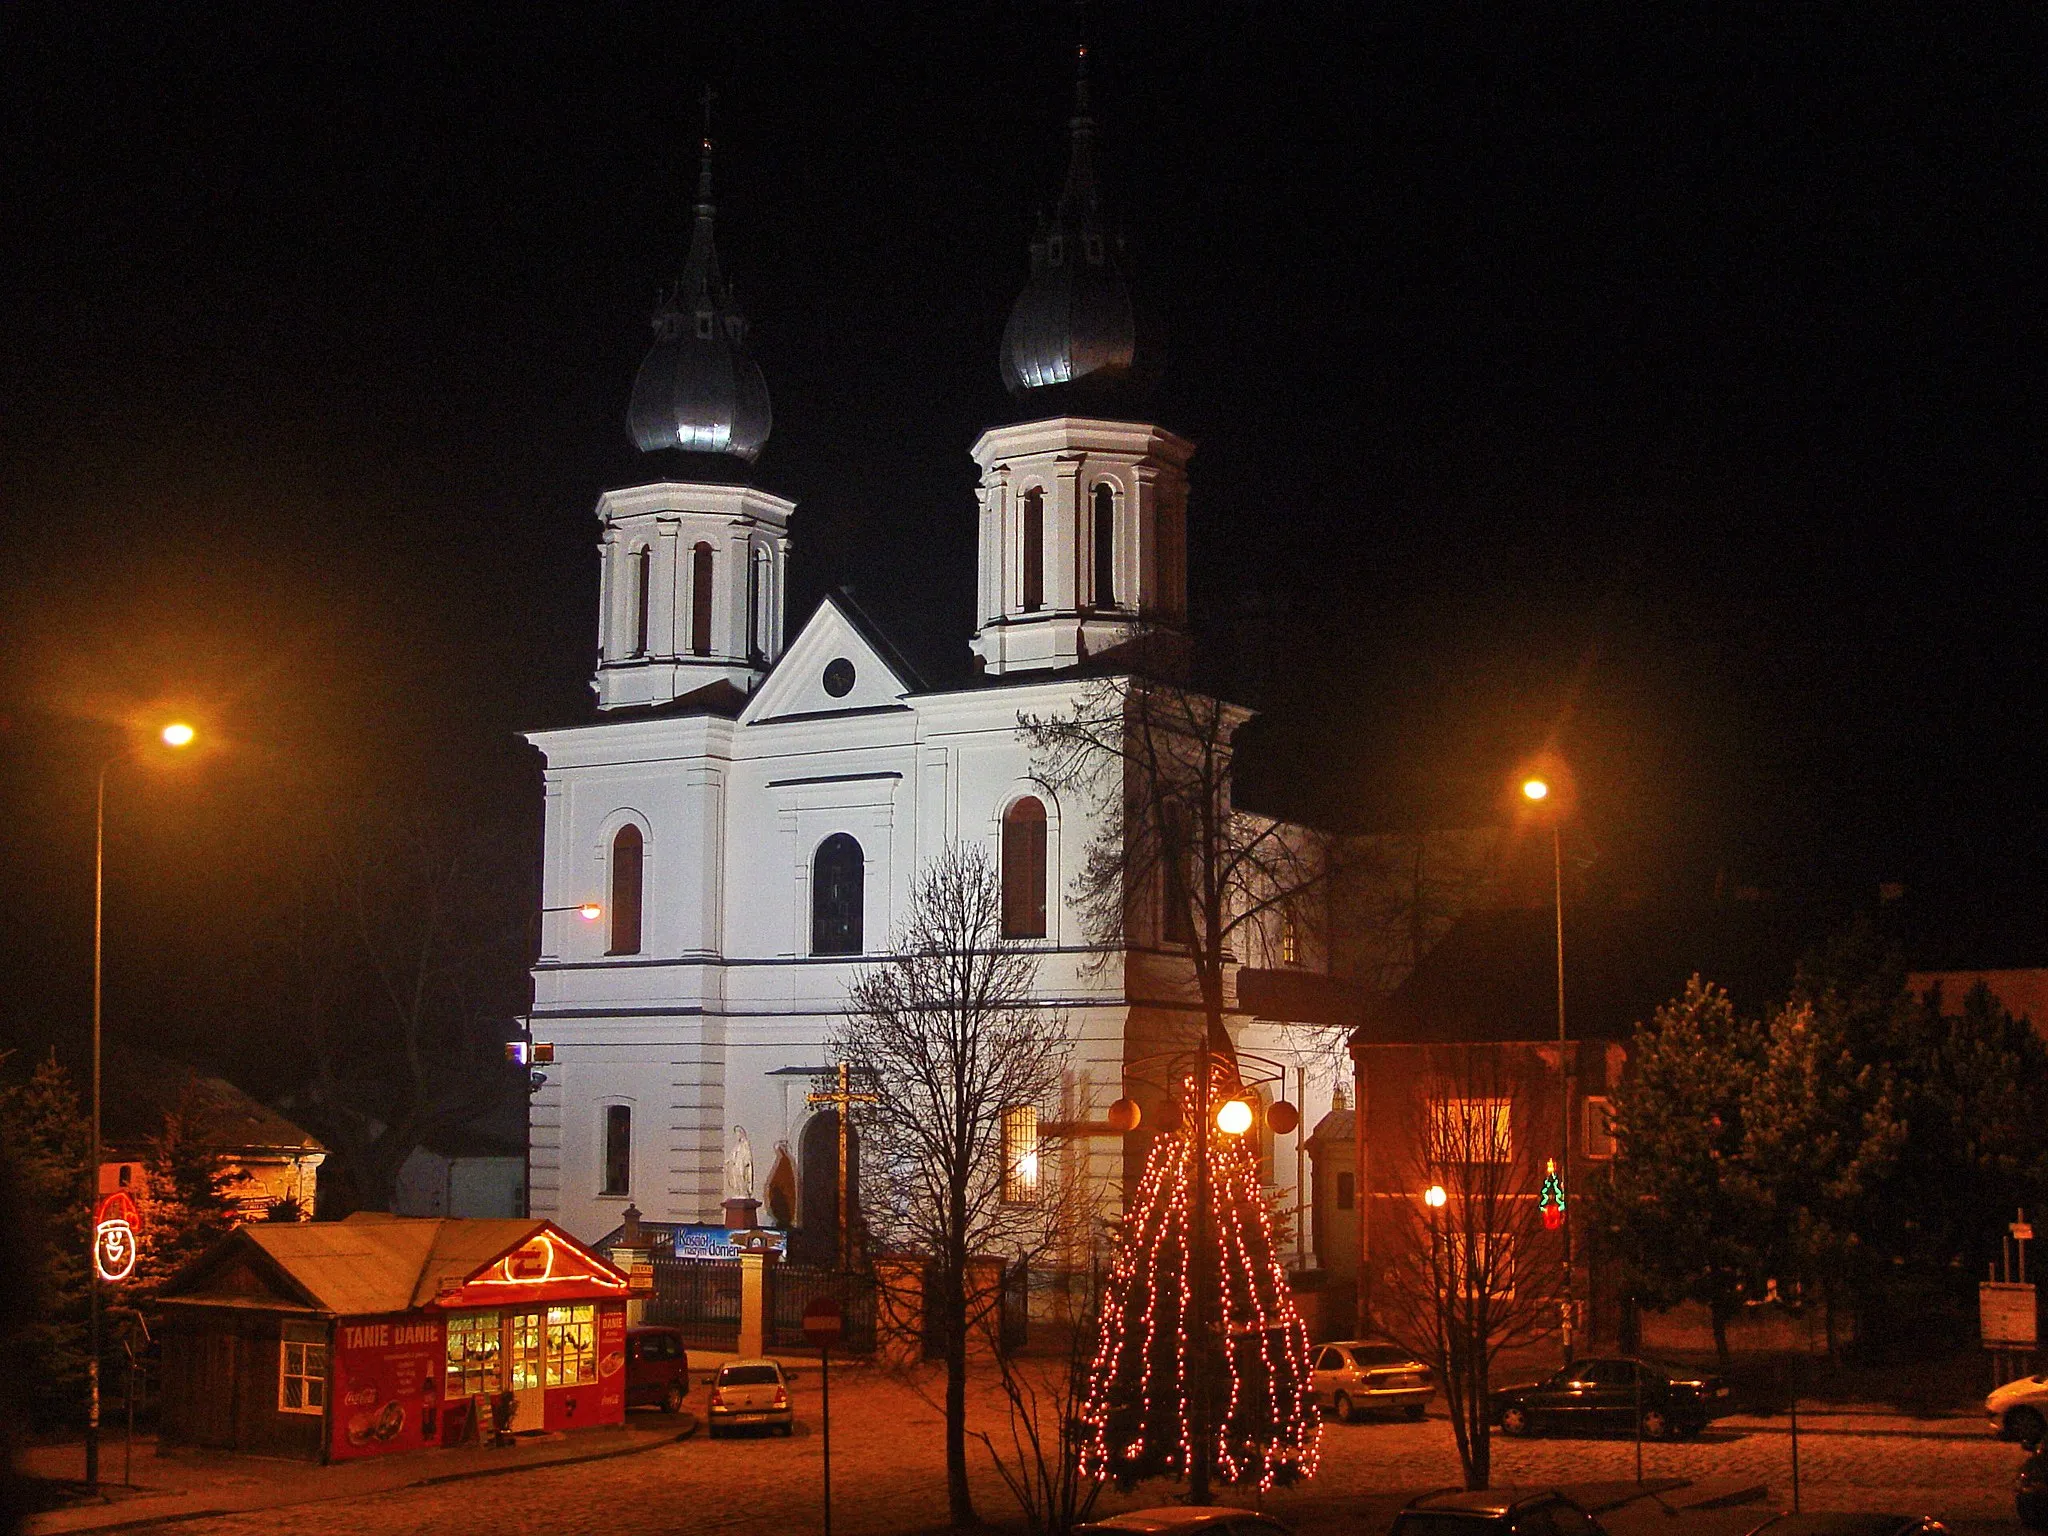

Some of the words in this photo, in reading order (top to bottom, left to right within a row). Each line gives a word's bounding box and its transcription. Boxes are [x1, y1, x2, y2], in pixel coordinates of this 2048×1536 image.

[602, 1318, 623, 1329] DANIE
[345, 1324, 388, 1350] TANIE
[394, 1323, 439, 1345] DANIE
